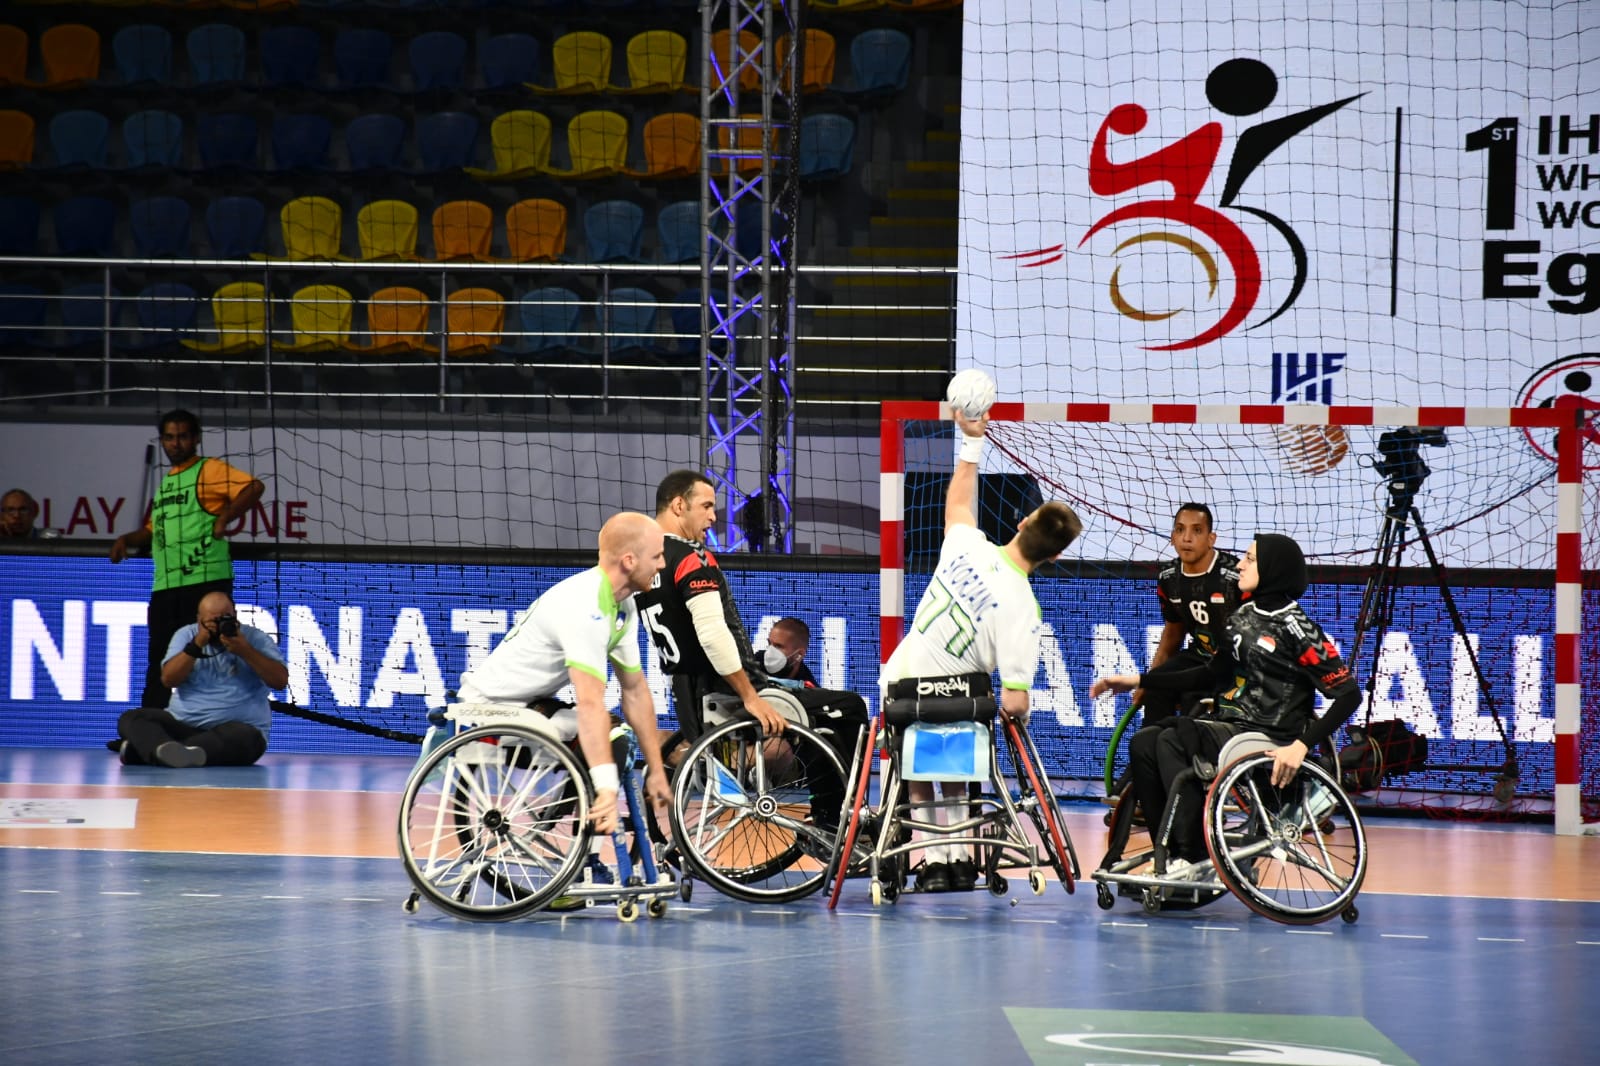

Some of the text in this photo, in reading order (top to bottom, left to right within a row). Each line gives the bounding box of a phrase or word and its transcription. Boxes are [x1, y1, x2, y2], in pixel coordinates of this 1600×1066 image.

[1491, 127, 1515, 141] ST
[1483, 240, 1600, 315] Eg
[1270, 352, 1347, 405] IHF
[35, 496, 125, 535] LAY
[914, 575, 978, 660] 77
